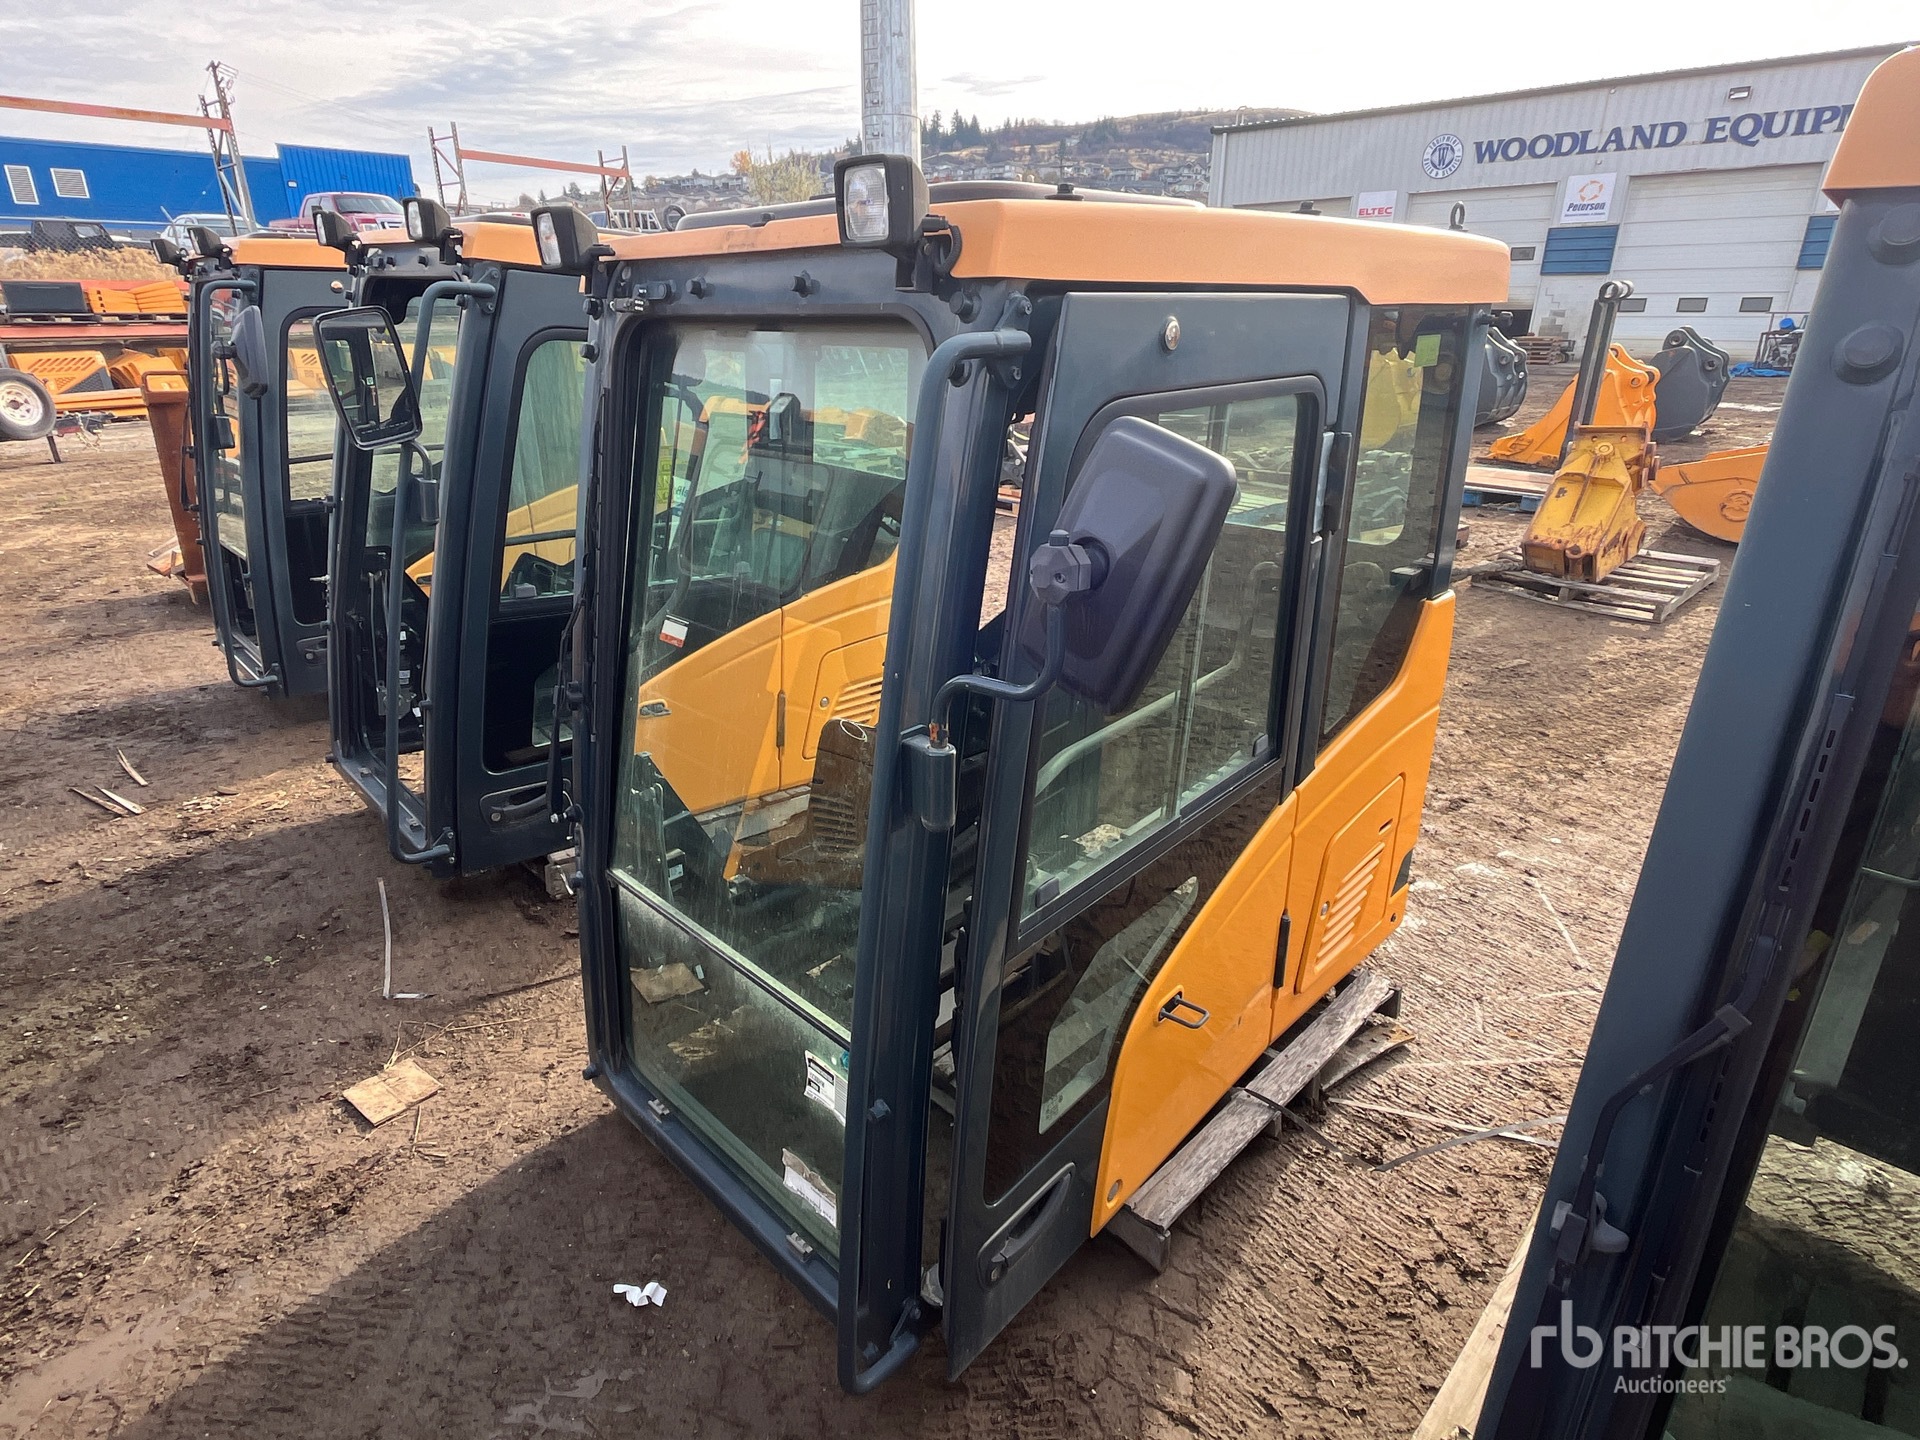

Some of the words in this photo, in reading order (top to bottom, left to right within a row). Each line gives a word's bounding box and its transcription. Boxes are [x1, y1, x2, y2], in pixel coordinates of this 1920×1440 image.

[1473, 120, 1688, 164] WOODLAND
[1358, 206, 1394, 216] ELTEC
[1566, 202, 1606, 212] Peterson
